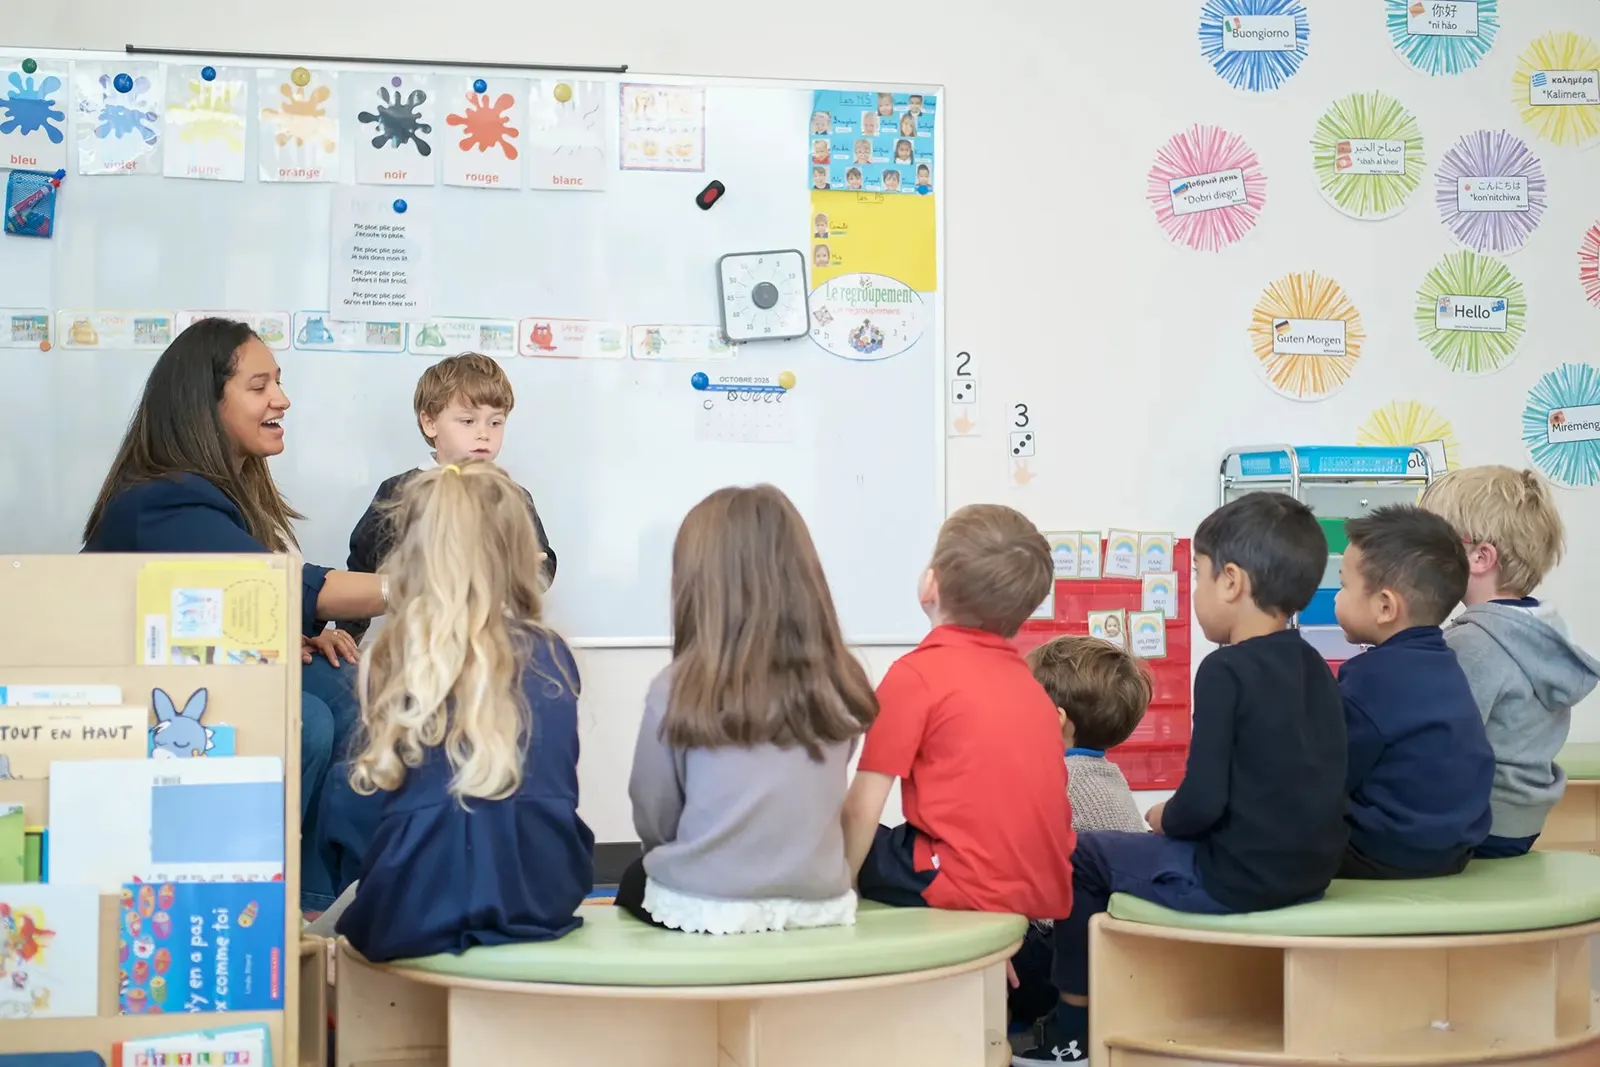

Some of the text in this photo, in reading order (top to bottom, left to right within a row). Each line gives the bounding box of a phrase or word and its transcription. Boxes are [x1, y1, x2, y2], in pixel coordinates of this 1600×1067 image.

[1432, 4, 1457, 18] 你好
[1232, 28, 1289, 40] Buongiorno
[1552, 76, 1593, 86] καλημέρα
[1377, 143, 1401, 156] صباح
[10, 155, 37, 165] bleu
[103, 160, 137, 170] violet
[187, 165, 220, 176] jaune
[279, 168, 320, 179] orange
[384, 170, 407, 179] noir
[465, 173, 499, 184] rouge
[553, 176, 583, 185] blanc
[1186, 175, 1238, 190] Добрый день
[1478, 182, 1520, 190] こんにちは
[826, 281, 913, 307] Le regroupement
[843, 307, 900, 315] regroupement
[1455, 305, 1490, 318] Hello
[1277, 334, 1341, 346] Guten Morgen
[956, 351, 971, 376] 2
[1015, 403, 1029, 427] 3
[51, 729, 71, 739] EN
[83, 726, 133, 740] HAUT
[212, 908, 229, 930] toi
[190, 915, 209, 946] pas
[190, 951, 202, 962] a
[216, 936, 230, 995] comme
[189, 967, 203, 989] en
